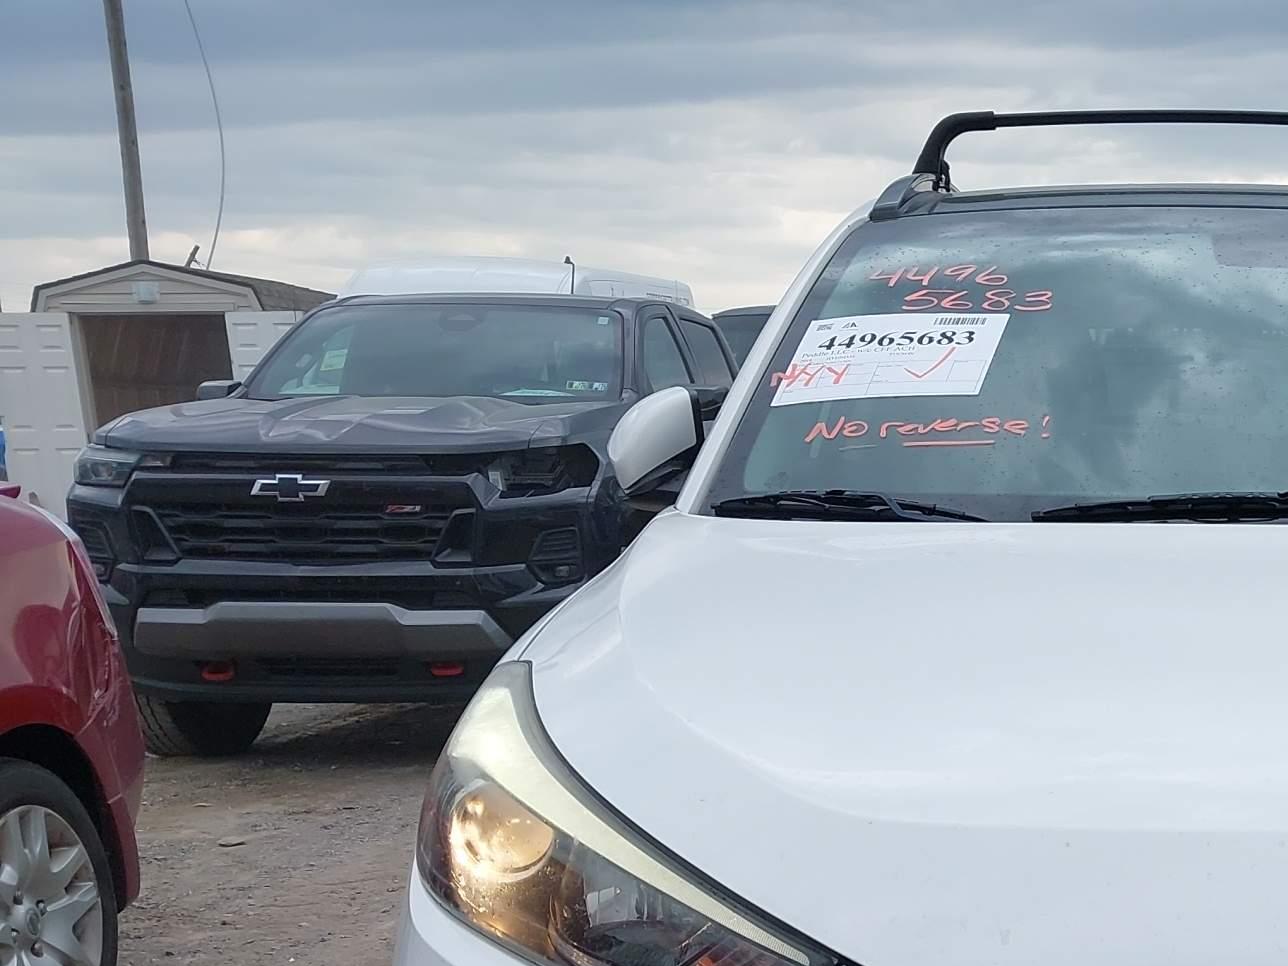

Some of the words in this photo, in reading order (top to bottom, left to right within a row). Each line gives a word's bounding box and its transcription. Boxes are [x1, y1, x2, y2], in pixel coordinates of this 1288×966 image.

[869, 263, 1009, 288] 4496
[901, 288, 1053, 311] 5683
[817, 329, 977, 351] 44965683
